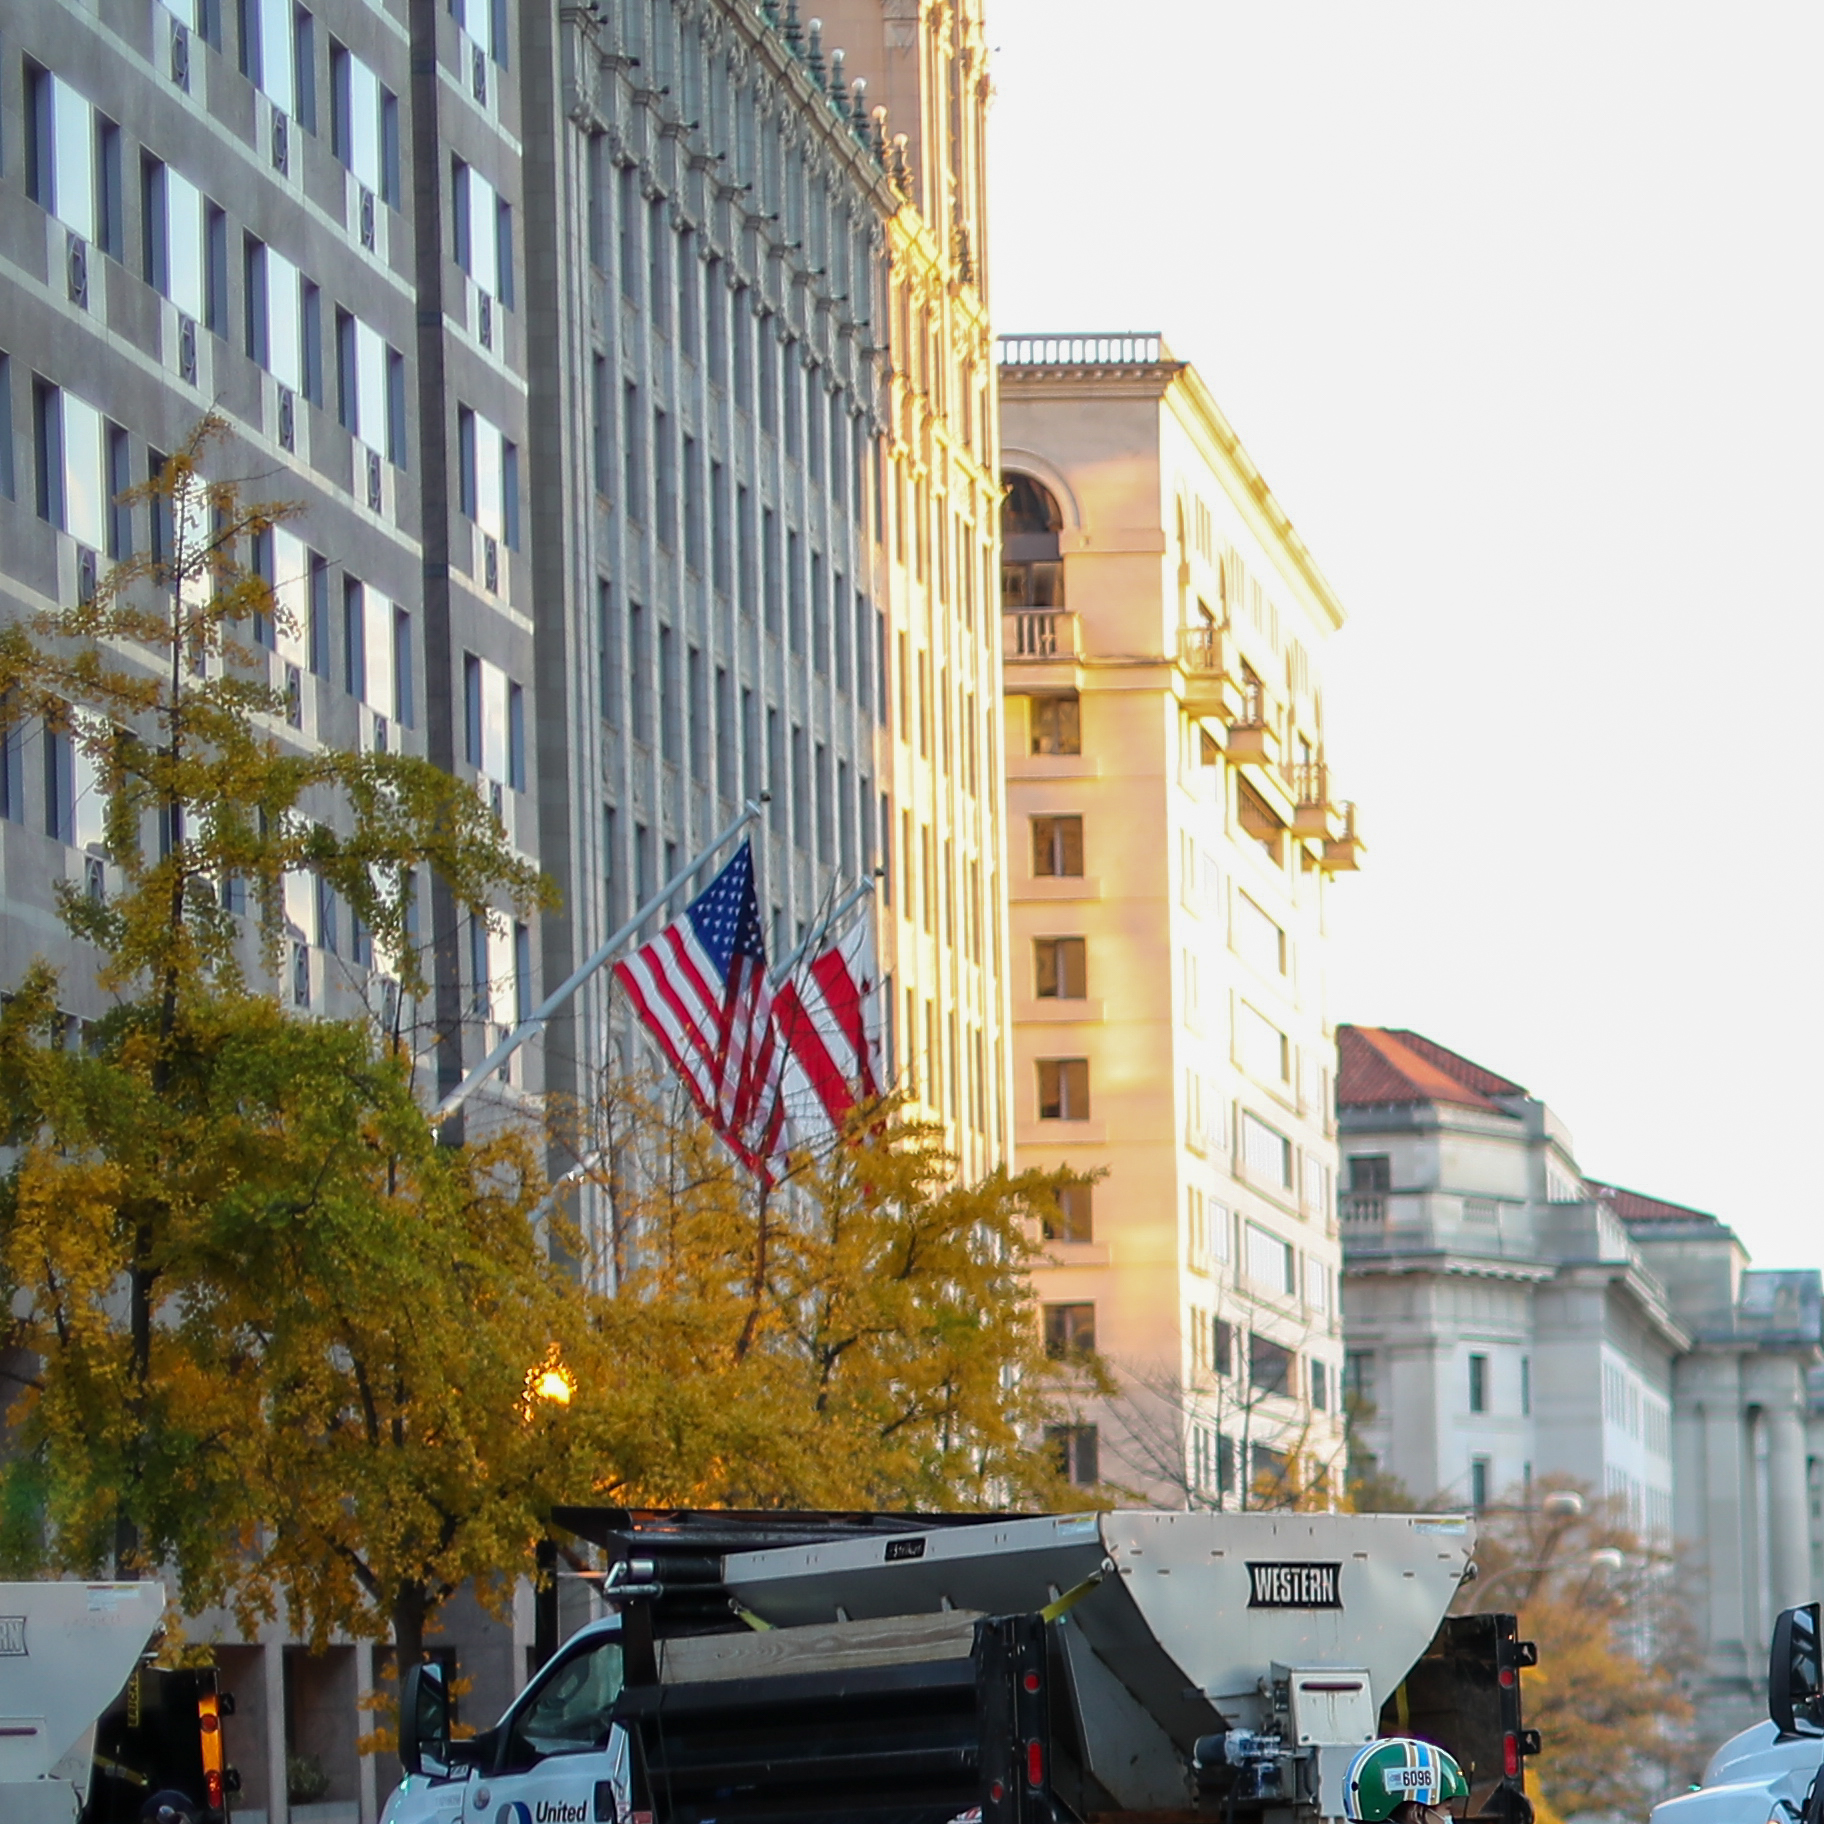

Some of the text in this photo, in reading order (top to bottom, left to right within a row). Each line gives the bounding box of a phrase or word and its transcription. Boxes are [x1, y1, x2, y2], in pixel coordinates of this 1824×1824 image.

[1254, 1567, 1335, 1603] WESTERN
[1403, 1770, 1432, 1787] 6096
[536, 1801, 588, 1823] United
